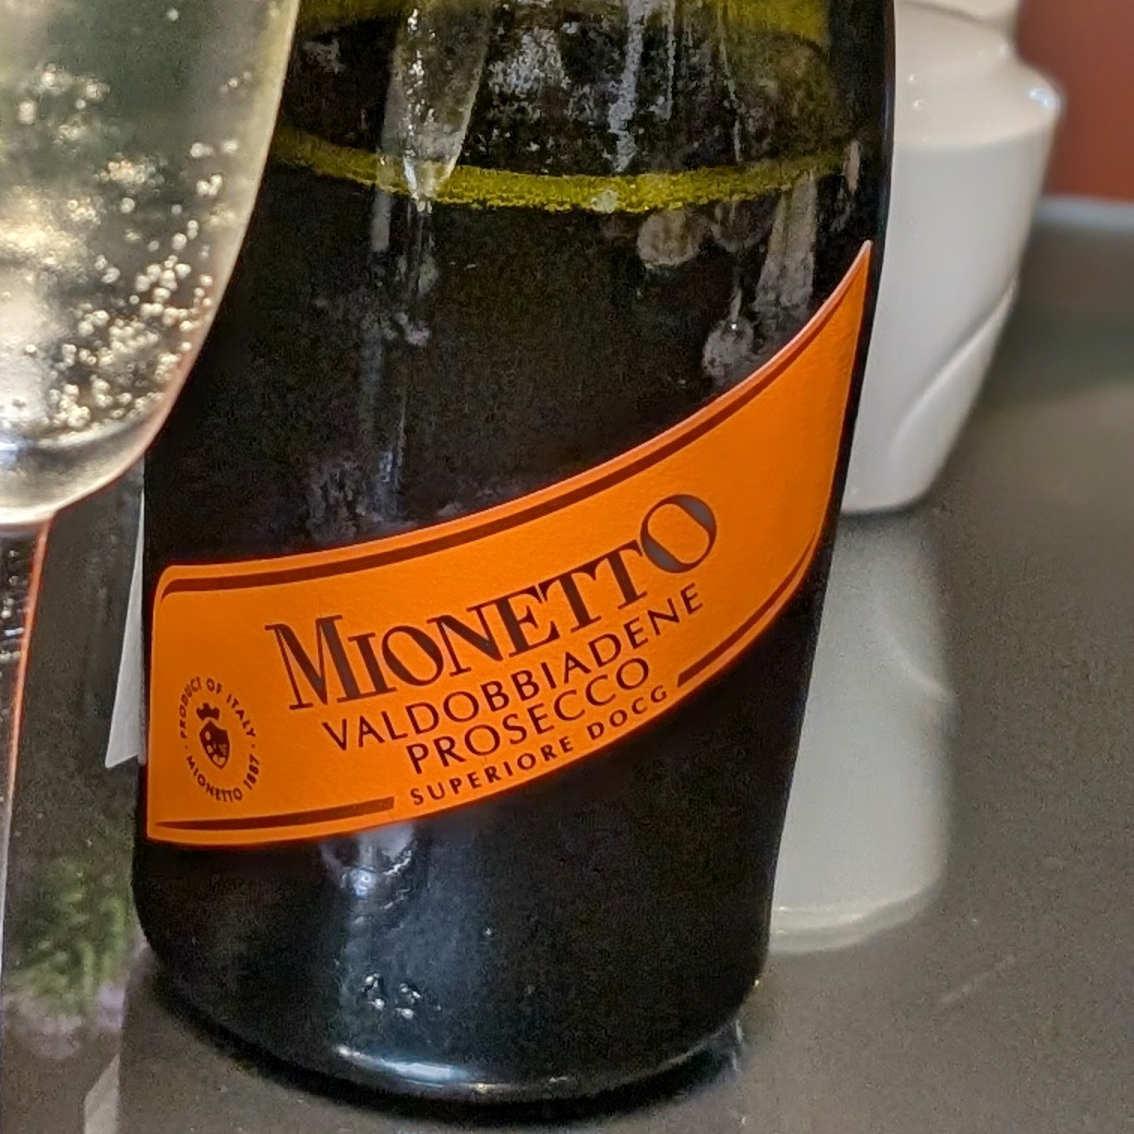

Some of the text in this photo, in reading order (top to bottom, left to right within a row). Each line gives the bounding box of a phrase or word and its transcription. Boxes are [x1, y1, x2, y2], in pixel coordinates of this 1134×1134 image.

[264, 493, 718, 711] MIONETTO
[206, 677, 223, 695] OF
[226, 693, 256, 737] ITALY
[322, 583, 704, 751] VALDOBBIADENE
[406, 657, 650, 775] PROSECCO
[186, 755, 243, 802] MIONETTO
[410, 684, 668, 806] SUPERIORE DOCG
